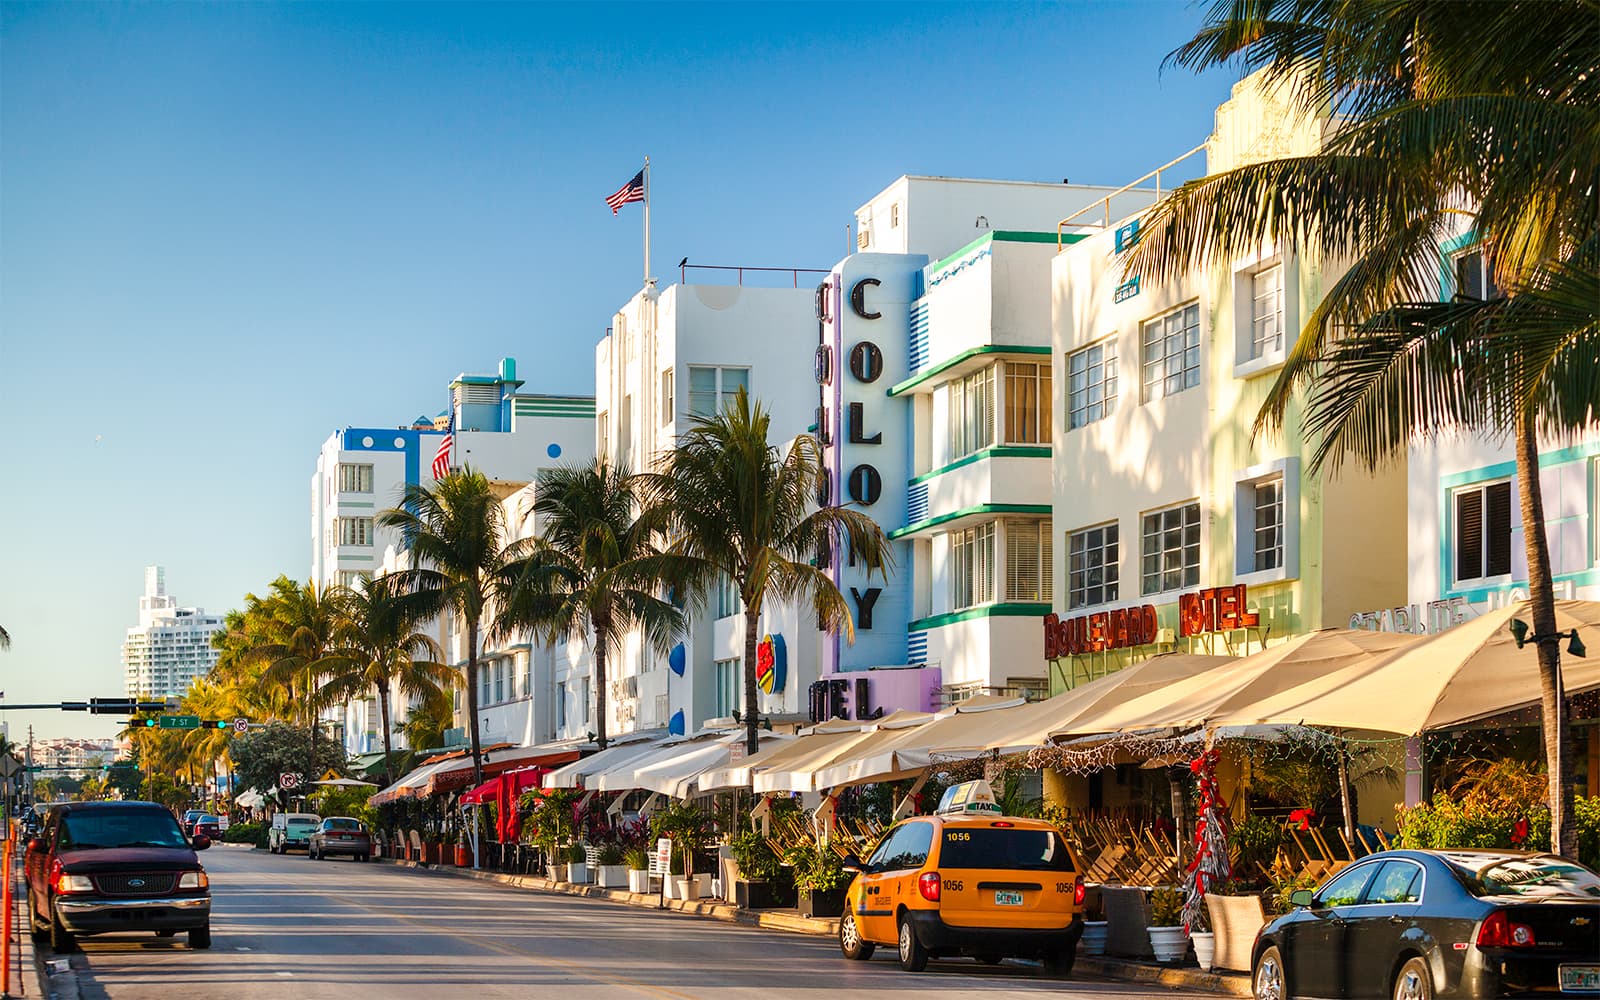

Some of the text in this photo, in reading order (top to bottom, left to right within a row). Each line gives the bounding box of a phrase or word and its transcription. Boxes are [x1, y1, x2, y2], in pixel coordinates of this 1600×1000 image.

[850, 277, 884, 630] COLOY
[1043, 604, 1158, 660] BOULEVARD
[171, 718, 176, 726] 7
[946, 832, 971, 842] 1056
[943, 879, 964, 891] 1056
[1056, 882, 1074, 893] 1056
